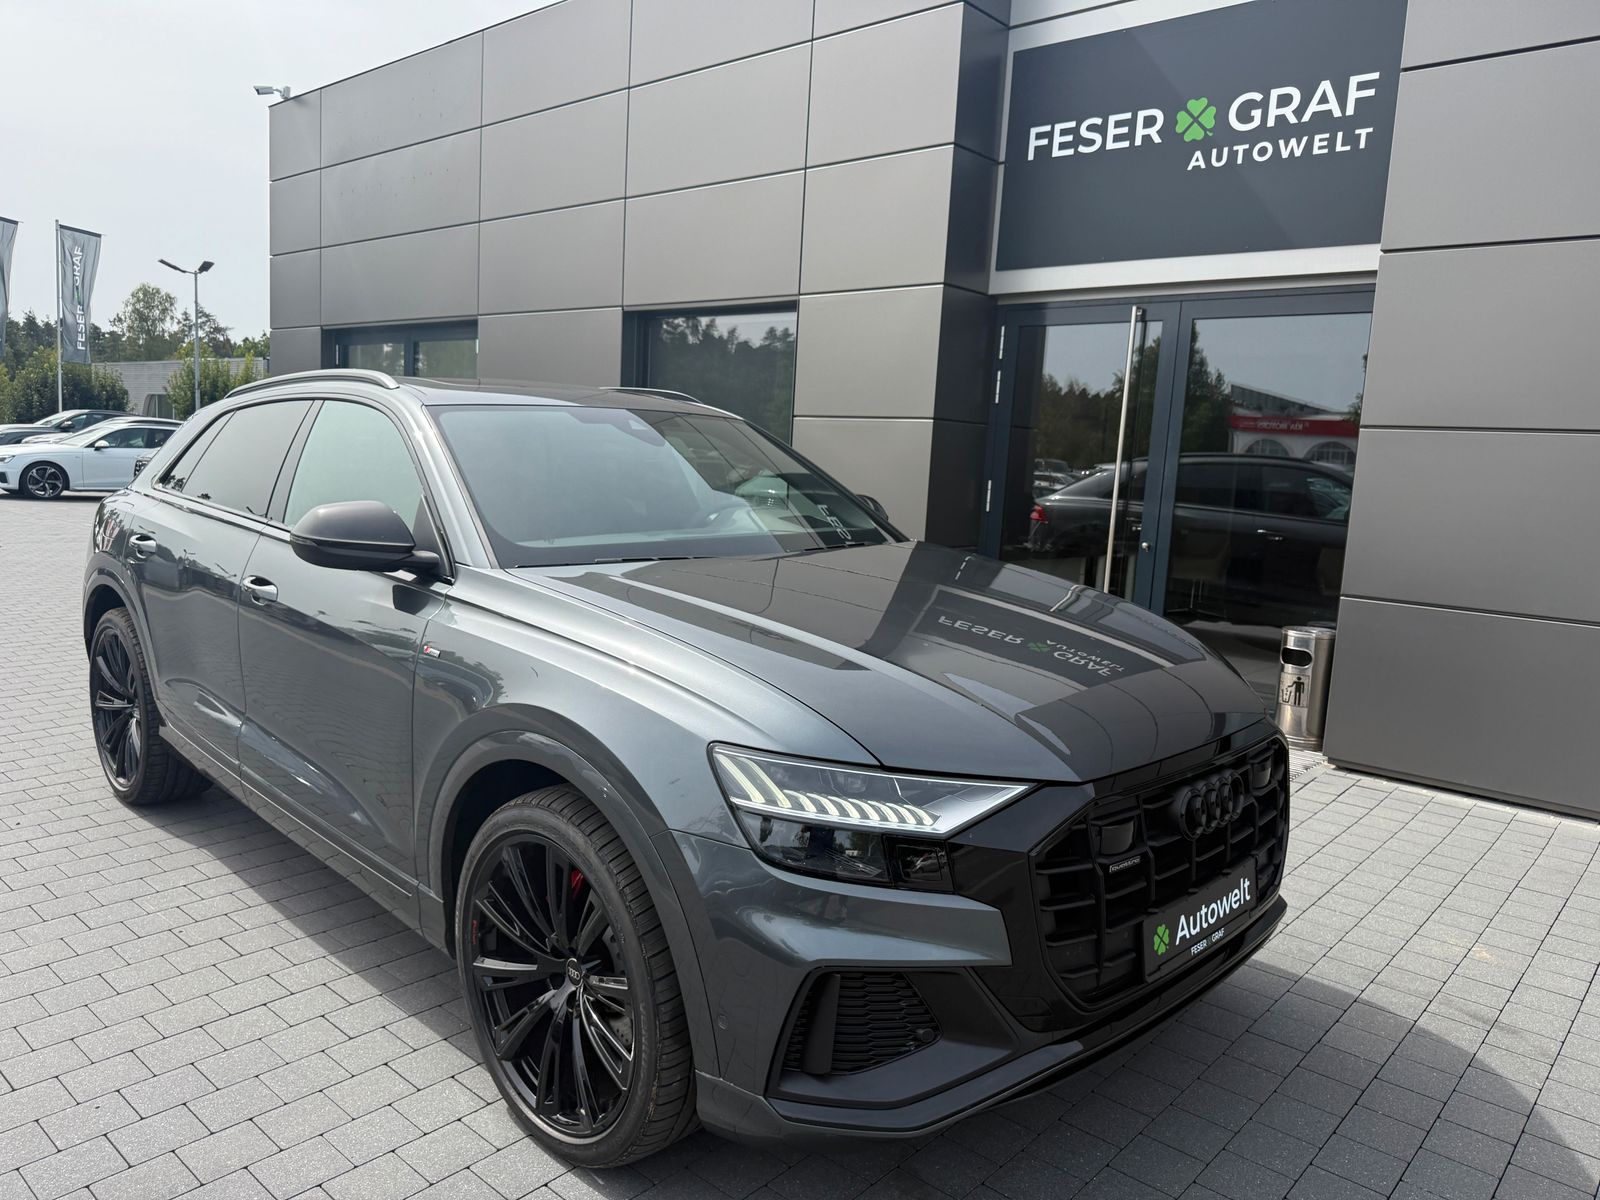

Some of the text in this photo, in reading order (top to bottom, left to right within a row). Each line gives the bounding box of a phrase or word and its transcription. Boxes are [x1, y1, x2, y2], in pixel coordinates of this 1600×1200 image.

[1027, 71, 1381, 161] FESER GRAF
[1186, 127, 1374, 171] AUTOWELT
[76, 304, 86, 350] FESER
[1175, 877, 1251, 946] Autowelt
[1190, 927, 1225, 956] FESER GRAF
